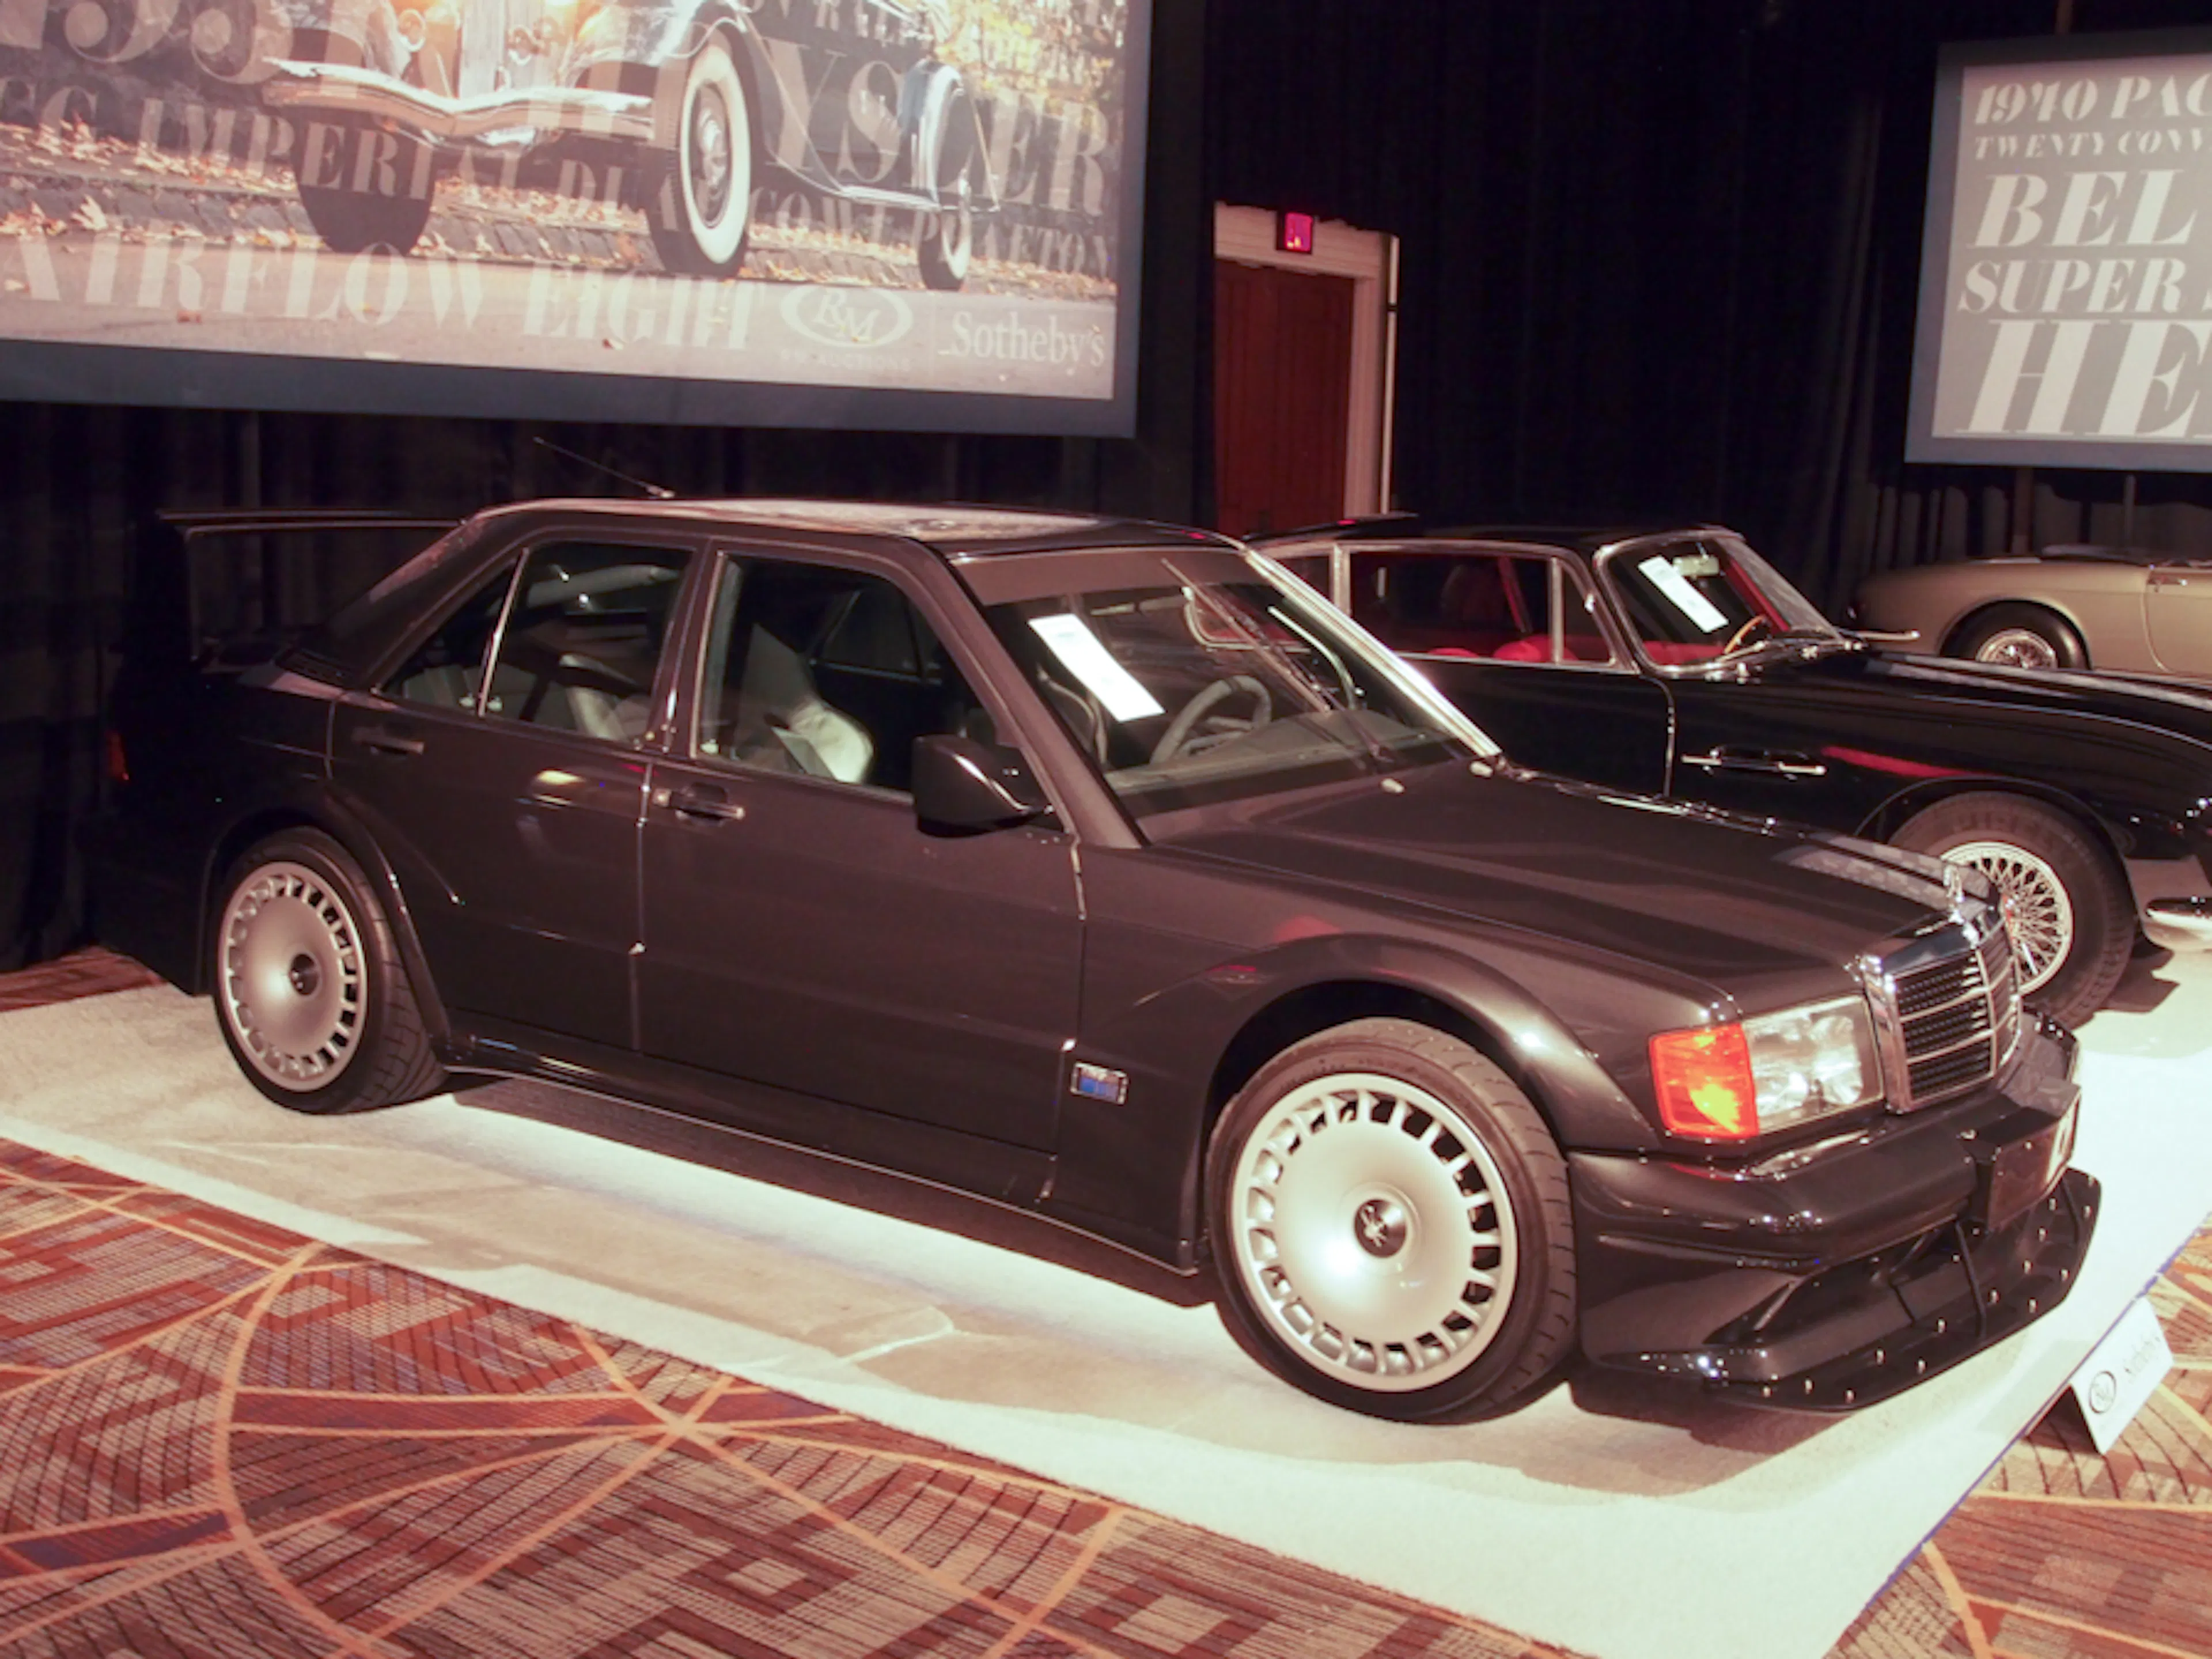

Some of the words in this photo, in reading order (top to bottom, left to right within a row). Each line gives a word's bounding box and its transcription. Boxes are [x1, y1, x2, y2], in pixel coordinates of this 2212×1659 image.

[1975, 78, 2099, 124] 1940
[1974, 131, 2105, 159] TWENTY
[1965, 169, 2197, 248] BEL
[0, 218, 500, 330] AIRFLOW
[520, 260, 768, 349] EIGHT
[1959, 257, 2187, 314] SUPER
[950, 310, 1105, 368] Sotheby's
[1954, 319, 2212, 438] HE
